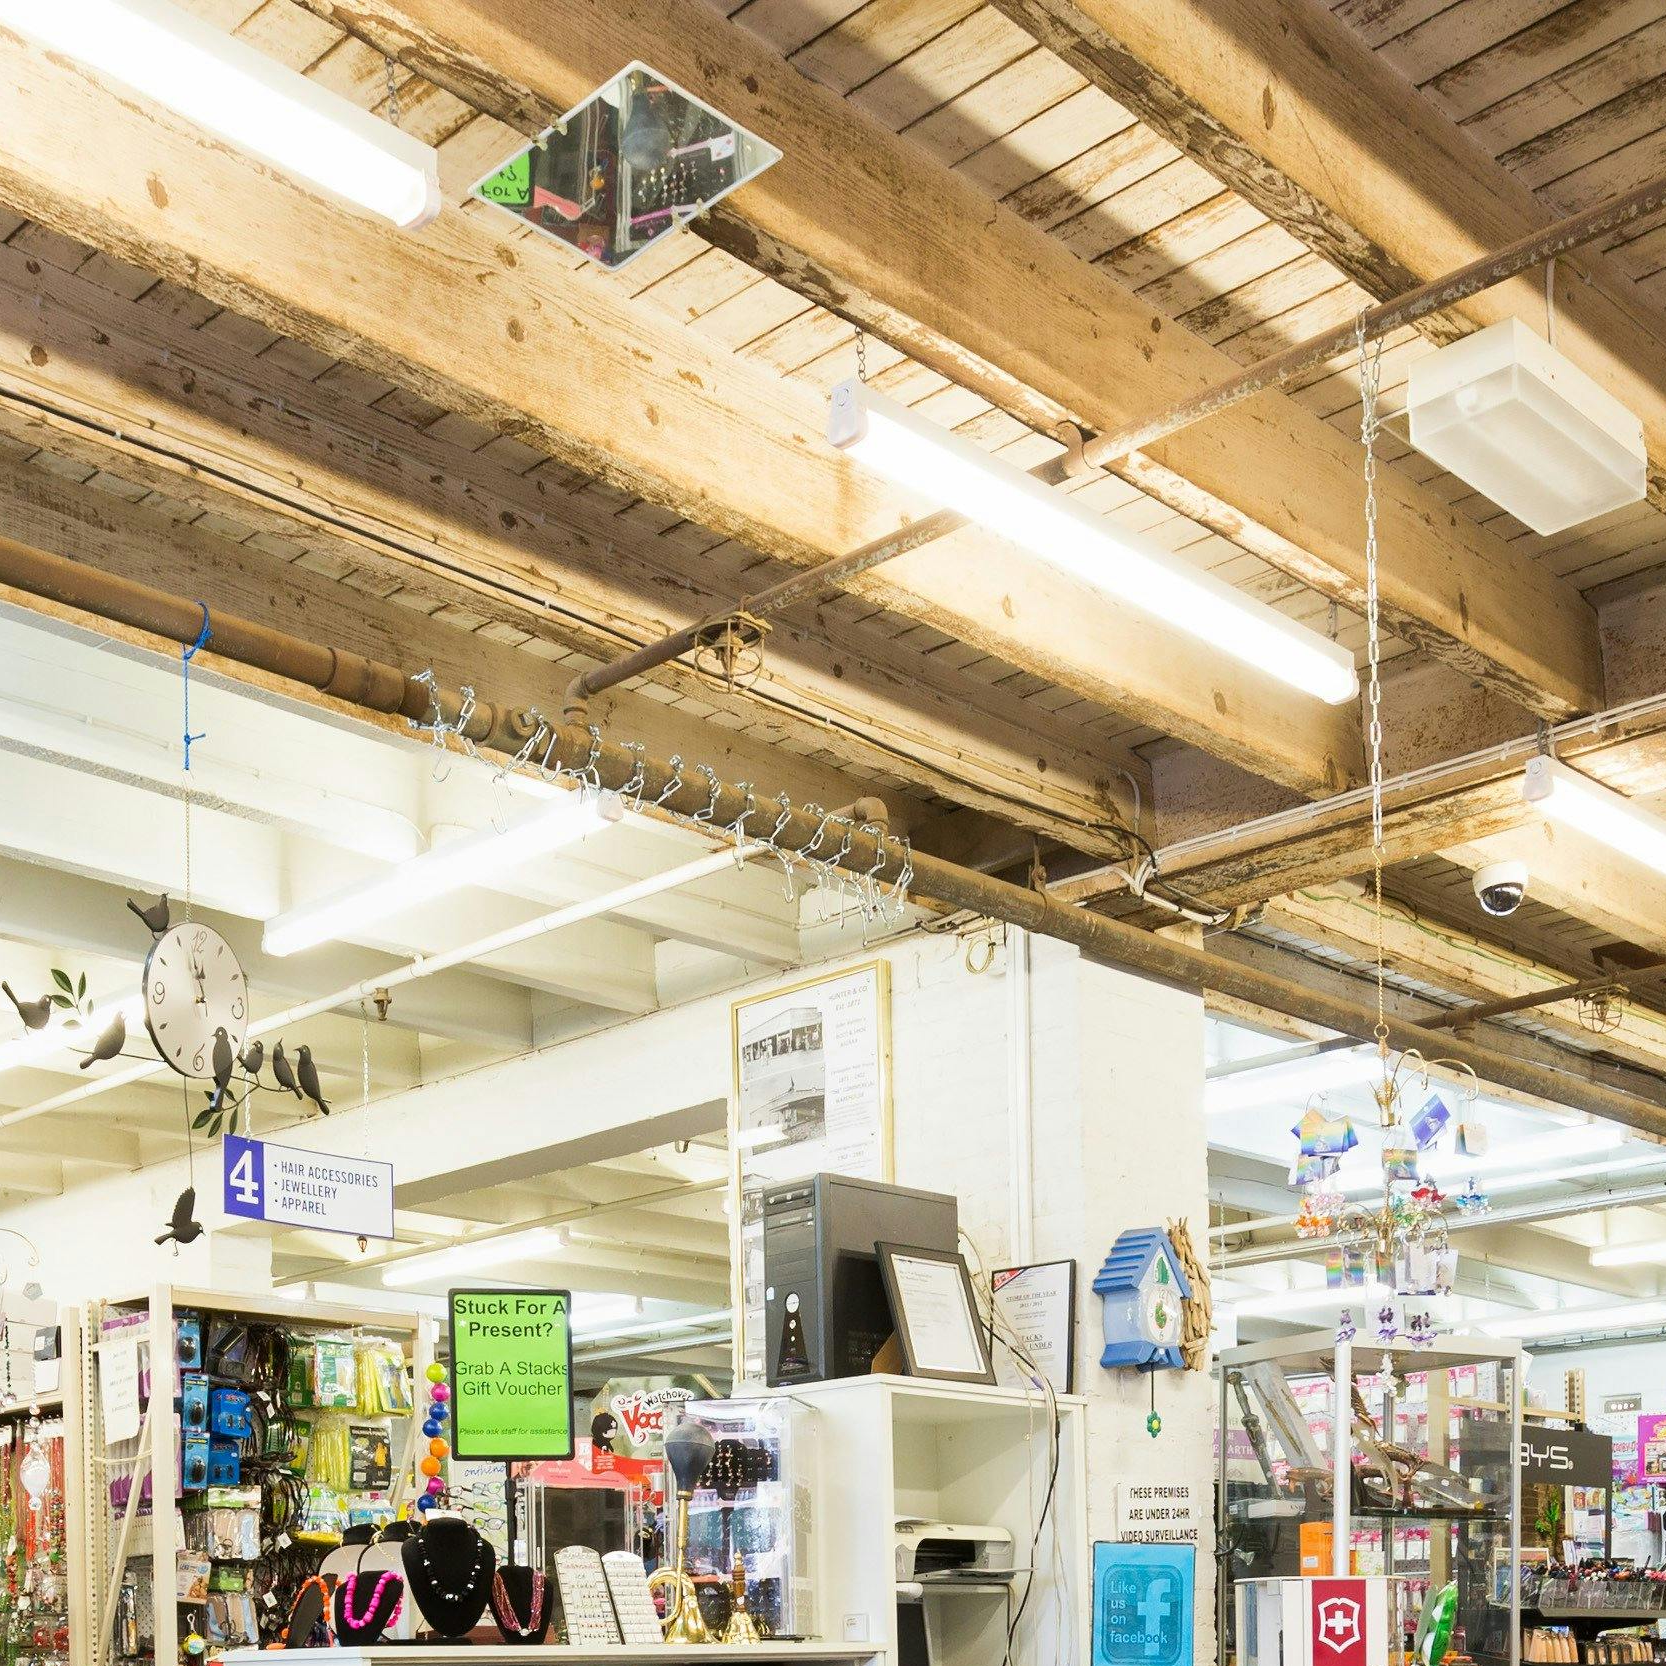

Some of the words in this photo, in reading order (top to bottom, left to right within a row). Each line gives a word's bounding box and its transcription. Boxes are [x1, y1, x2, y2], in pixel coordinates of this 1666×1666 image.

[191, 929, 208, 953] 12
[152, 981, 166, 1005] 9
[230, 997, 244, 1021] 3
[192, 1047, 205, 1073] 6
[228, 1149, 260, 1205] 4
[280, 1159, 305, 1176] HAIR
[307, 1163, 379, 1189] ACCESSORIES
[280, 1178, 338, 1200] JEWELLERY
[280, 1196, 327, 1217] APPAREL
[455, 1299, 509, 1315] Stuck
[515, 1299, 547, 1315] For
[552, 1300, 567, 1315] A
[469, 1321, 553, 1338] Present?
[455, 1361, 494, 1376] Grab
[499, 1361, 512, 1375] A
[517, 1361, 568, 1376] Stacks
[463, 1381, 491, 1396] Gift
[496, 1381, 563, 1396] Voucher
[645, 1389, 693, 1408] Watchover
[459, 1427, 485, 1436] Please
[486, 1427, 499, 1435] ask
[500, 1427, 518, 1435] staff
[518, 1427, 529, 1435] for
[530, 1428, 569, 1436] assistance
[1129, 1486, 1152, 1499] THESE
[1154, 1486, 1189, 1499] PREMISES
[1129, 1508, 1143, 1521] ARE
[1145, 1508, 1171, 1520] UNDER
[1171, 1508, 1190, 1519] 24HR
[1120, 1530, 1144, 1542] VIDEO
[1145, 1528, 1198, 1541] SURVEILLANCE
[1110, 1581, 1137, 1594] Like
[1110, 1601, 1126, 1609] us
[1110, 1615, 1127, 1624] on
[1109, 1630, 1169, 1644] facebook
